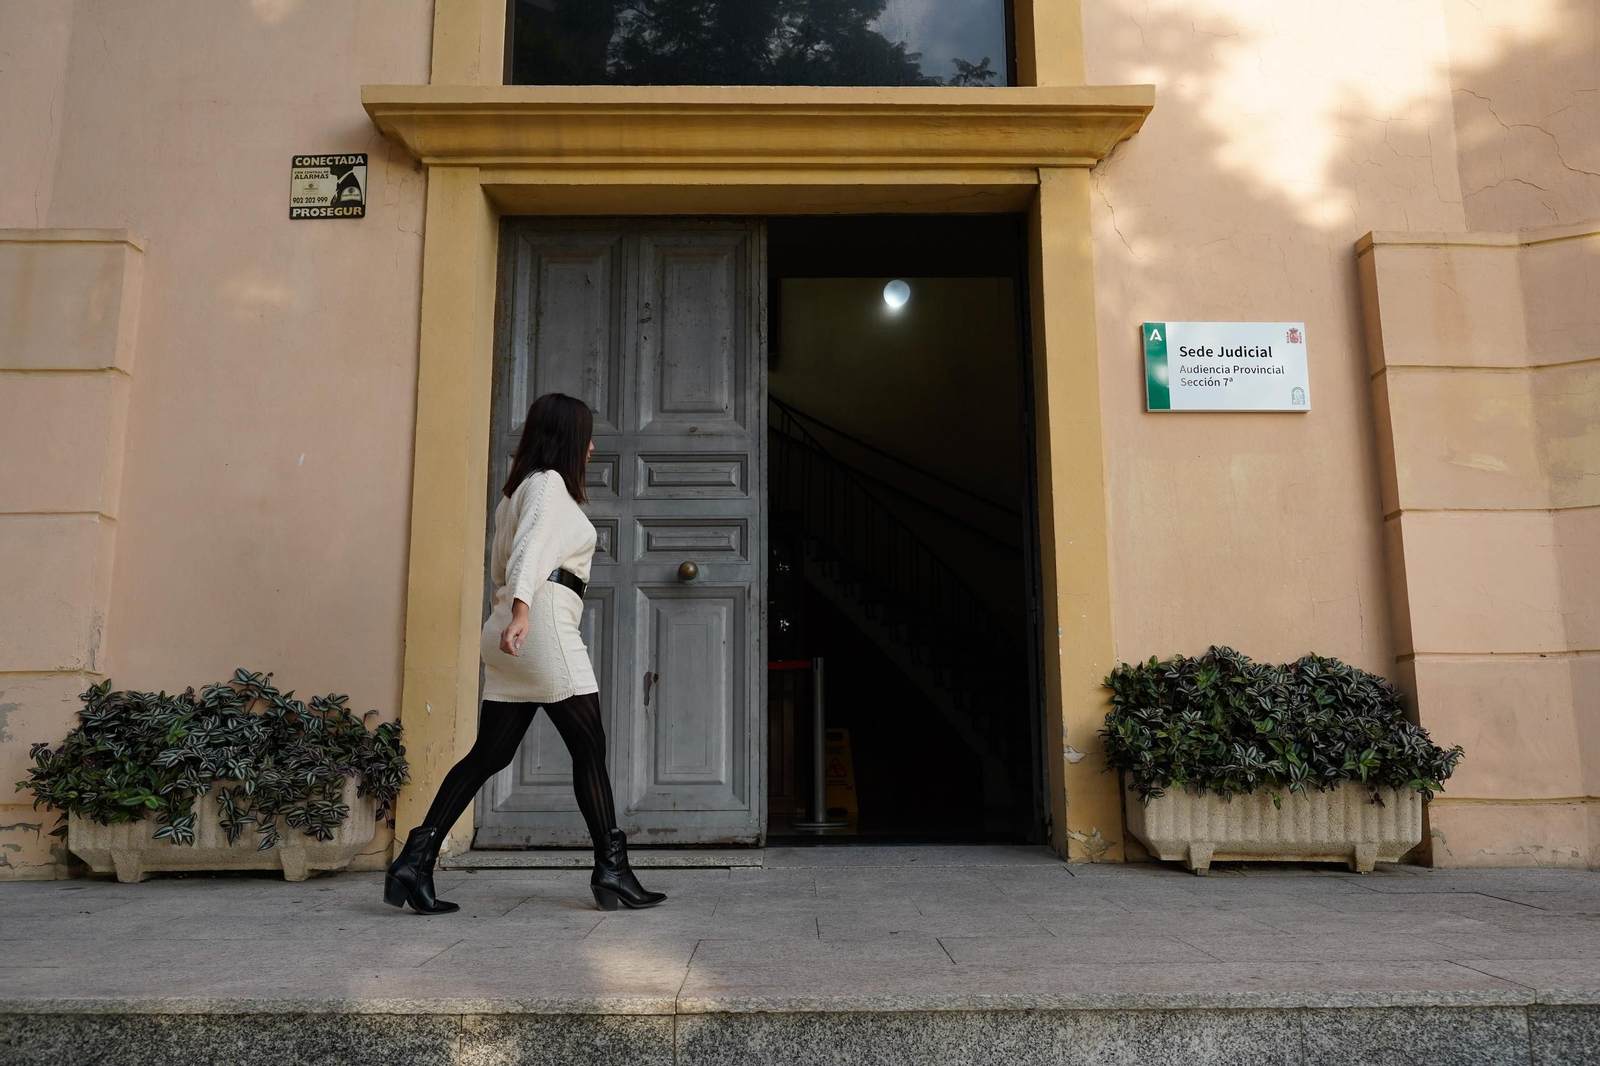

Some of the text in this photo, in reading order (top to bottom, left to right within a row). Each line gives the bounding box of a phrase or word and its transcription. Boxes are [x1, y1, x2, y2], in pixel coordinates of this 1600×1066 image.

[295, 155, 364, 166] CONECTADA
[292, 207, 363, 217] PROSEGUR
[1179, 346, 1273, 358] Sede Judicial
[1179, 364, 1285, 375] Audiencia Provincial
[1180, 377, 1234, 387] Sección 7ª
